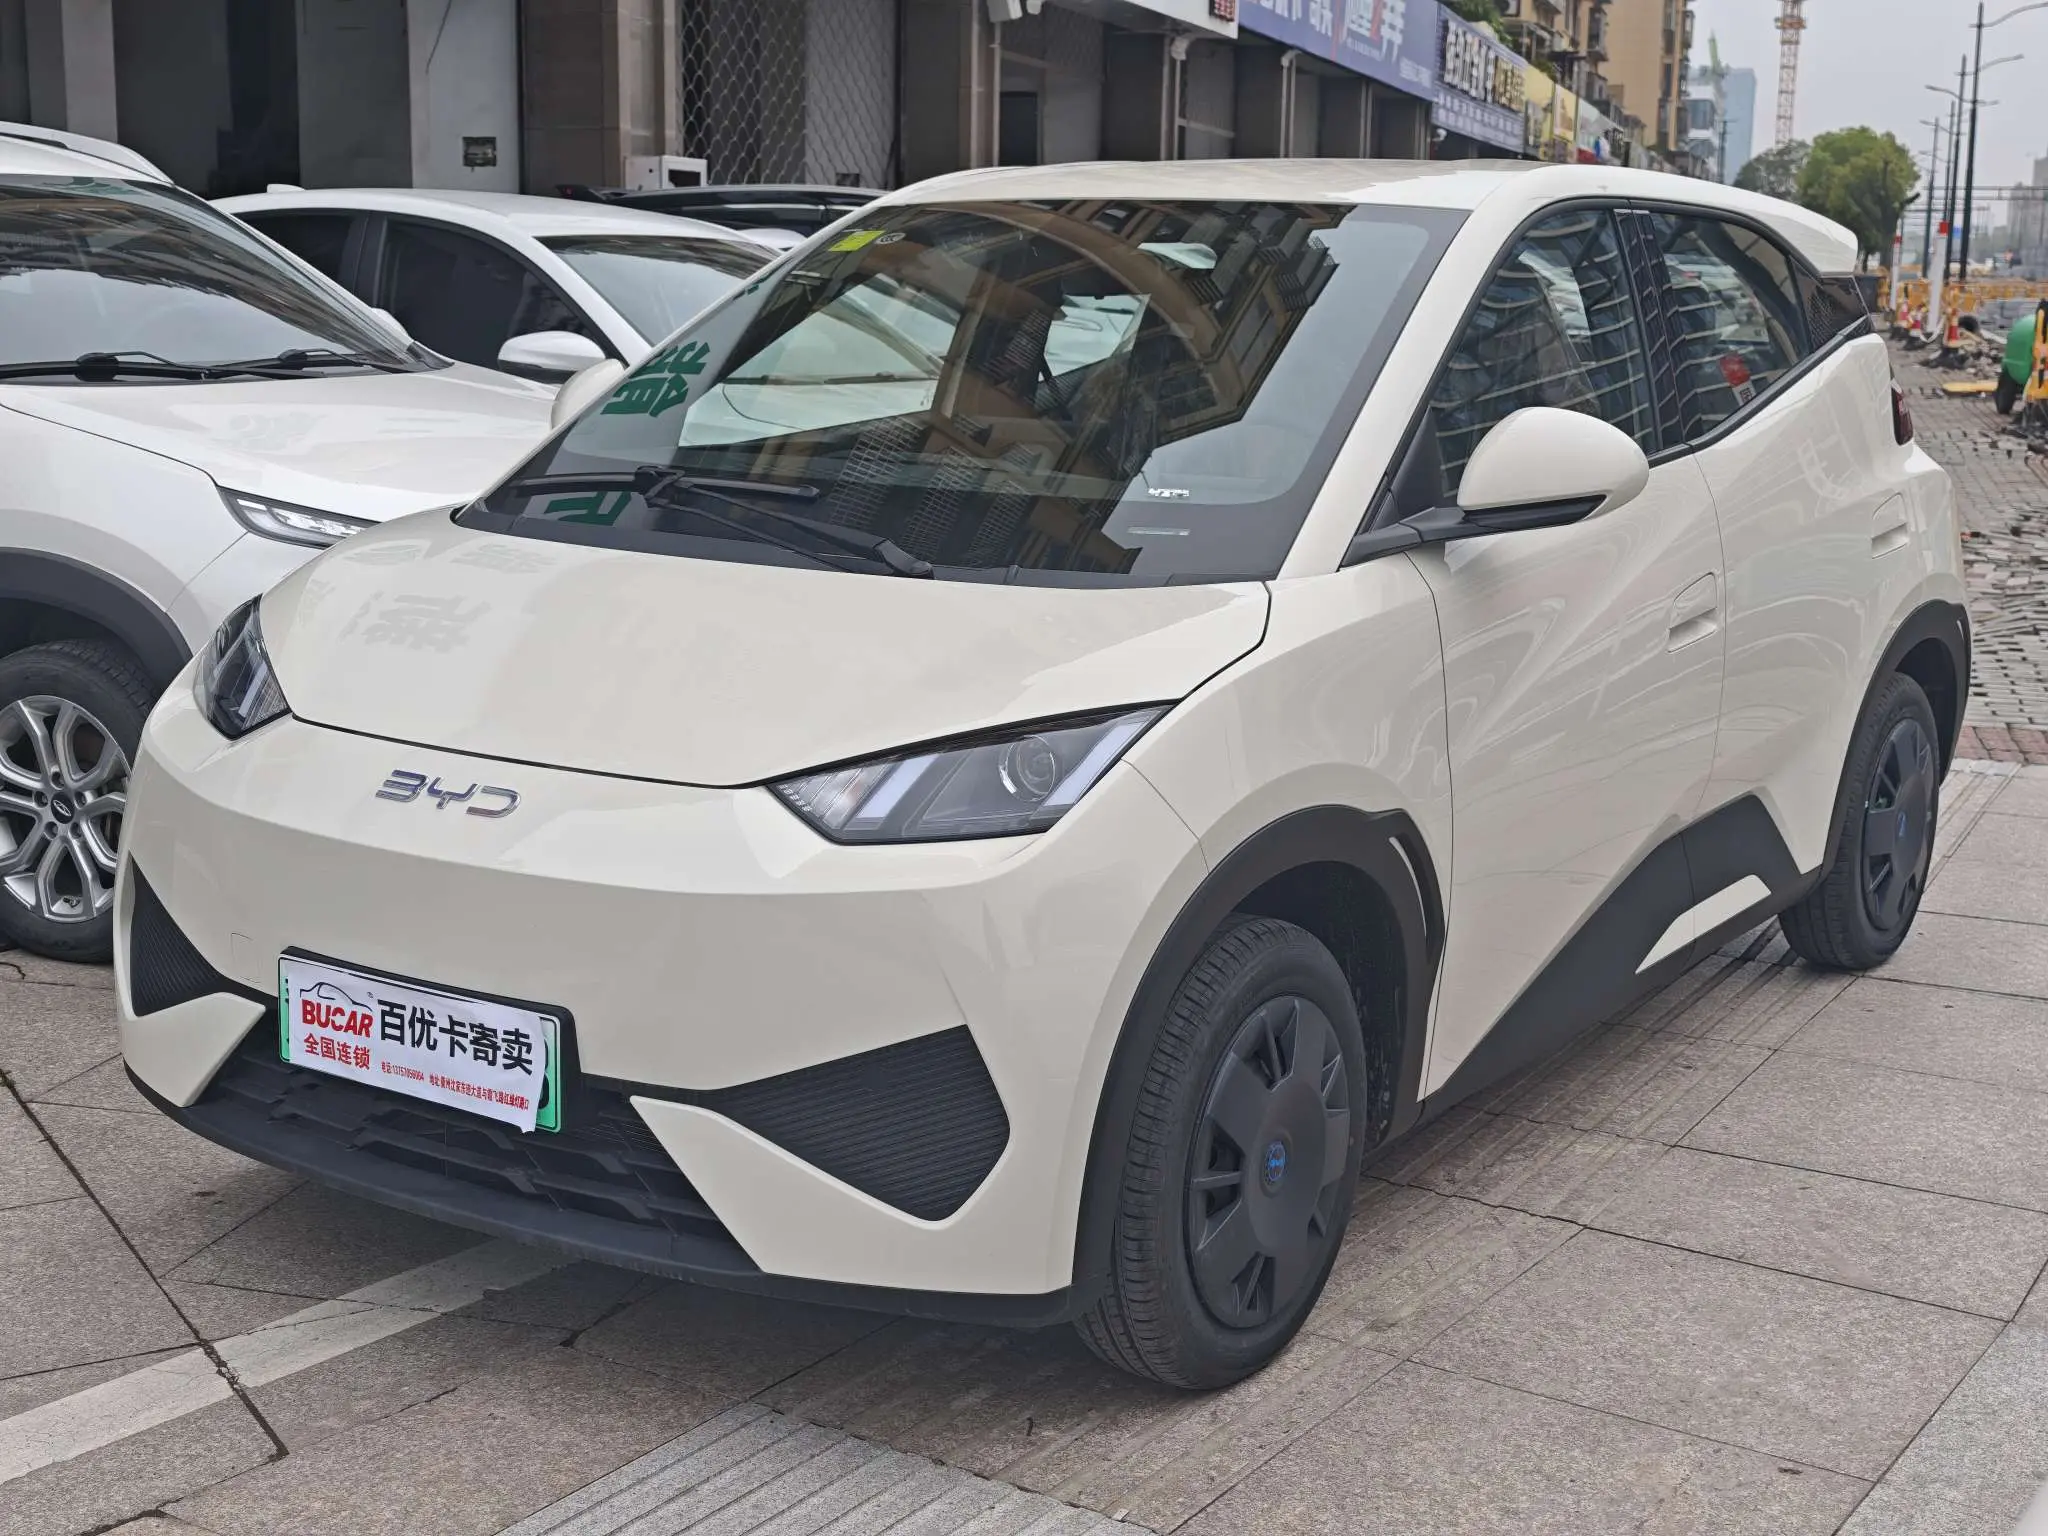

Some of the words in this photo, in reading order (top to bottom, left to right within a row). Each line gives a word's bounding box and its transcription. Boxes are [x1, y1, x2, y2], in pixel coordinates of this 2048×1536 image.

[376, 769, 522, 818] BYD
[301, 999, 374, 1037] BUCAR
[378, 1000, 533, 1075] 百优卡寄卖
[304, 1032, 371, 1070] 全国连锁
